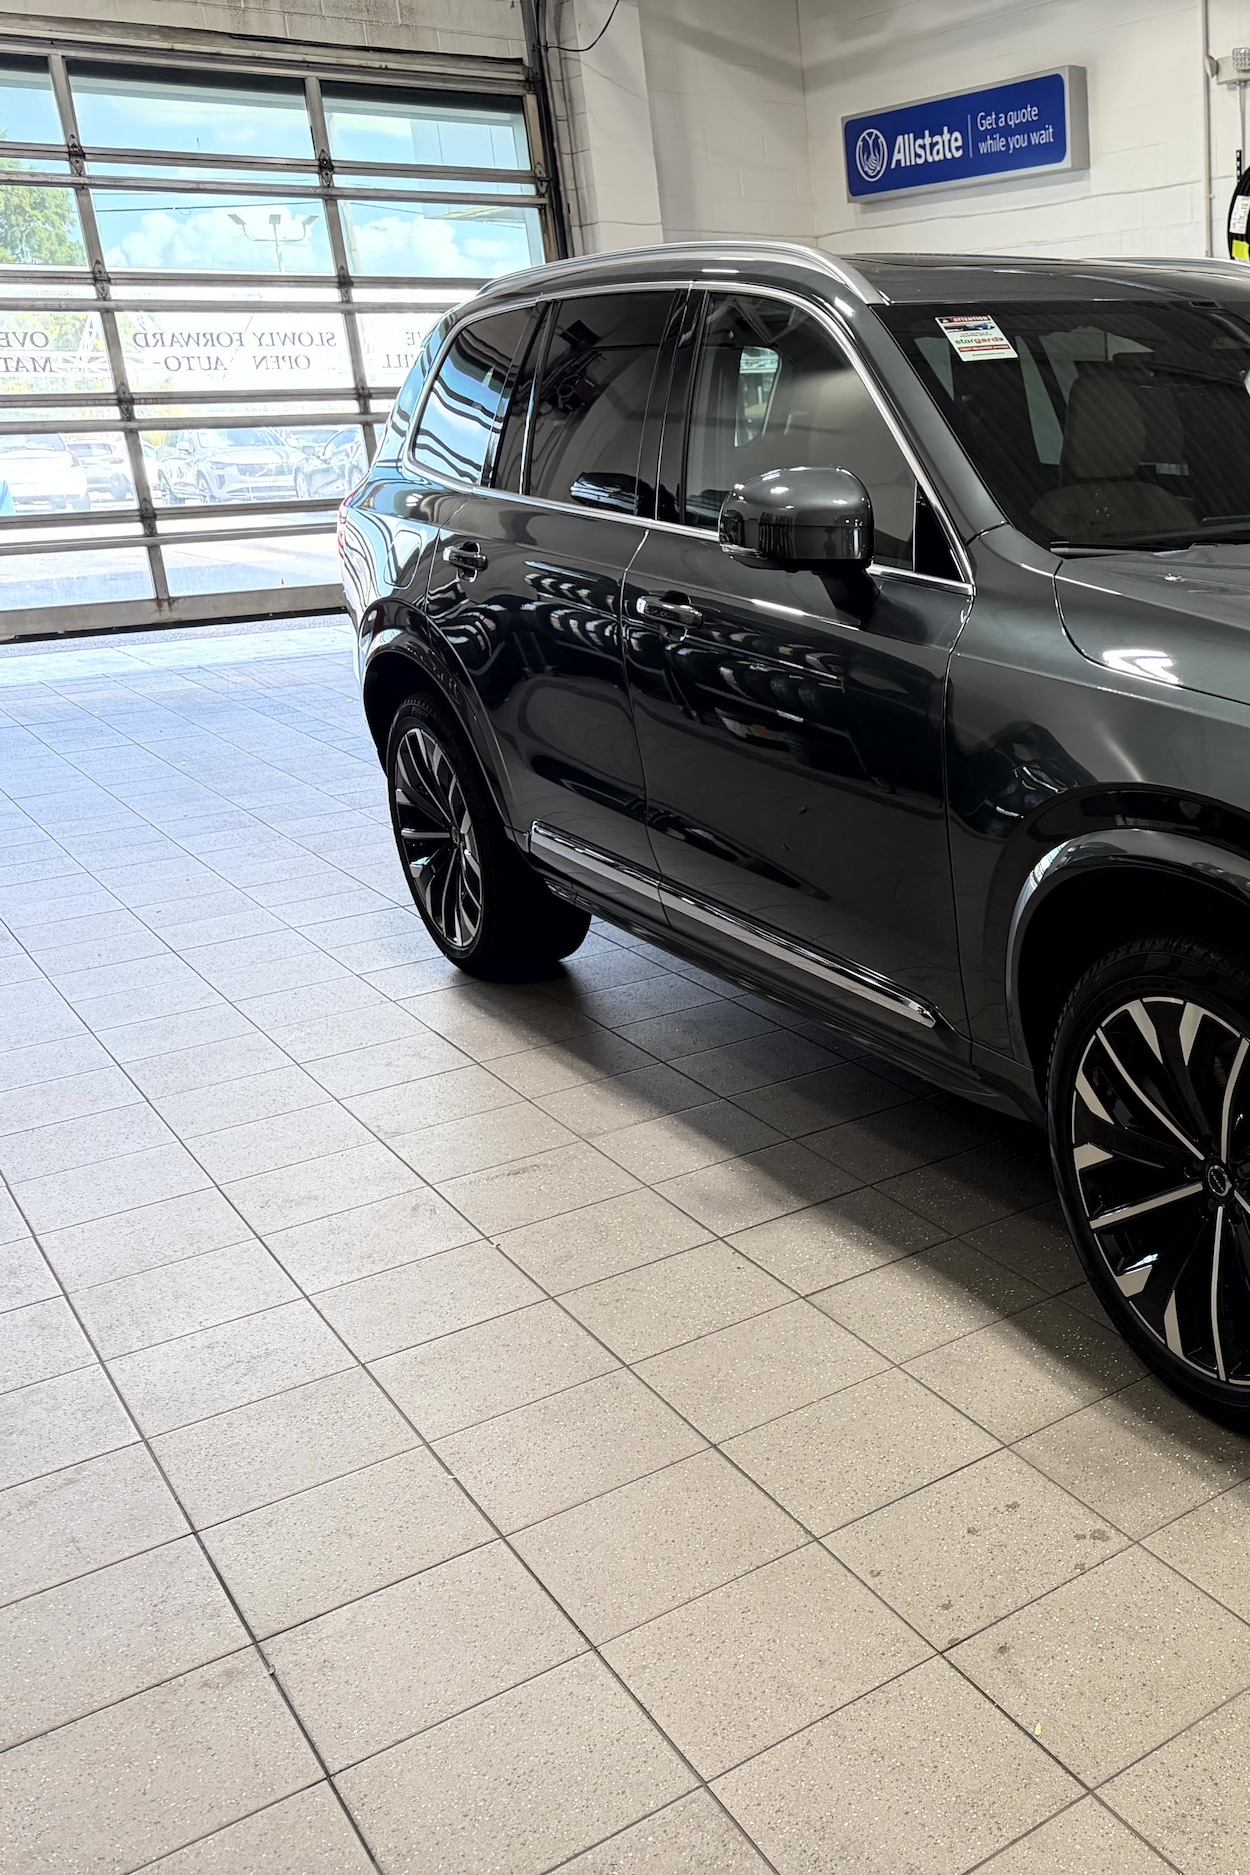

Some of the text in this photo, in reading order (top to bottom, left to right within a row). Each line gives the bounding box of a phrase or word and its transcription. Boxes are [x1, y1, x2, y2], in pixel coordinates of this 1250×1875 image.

[977, 104, 1039, 131] Get a quote
[890, 126, 964, 169] Allstate
[978, 124, 1054, 155] while you wait
